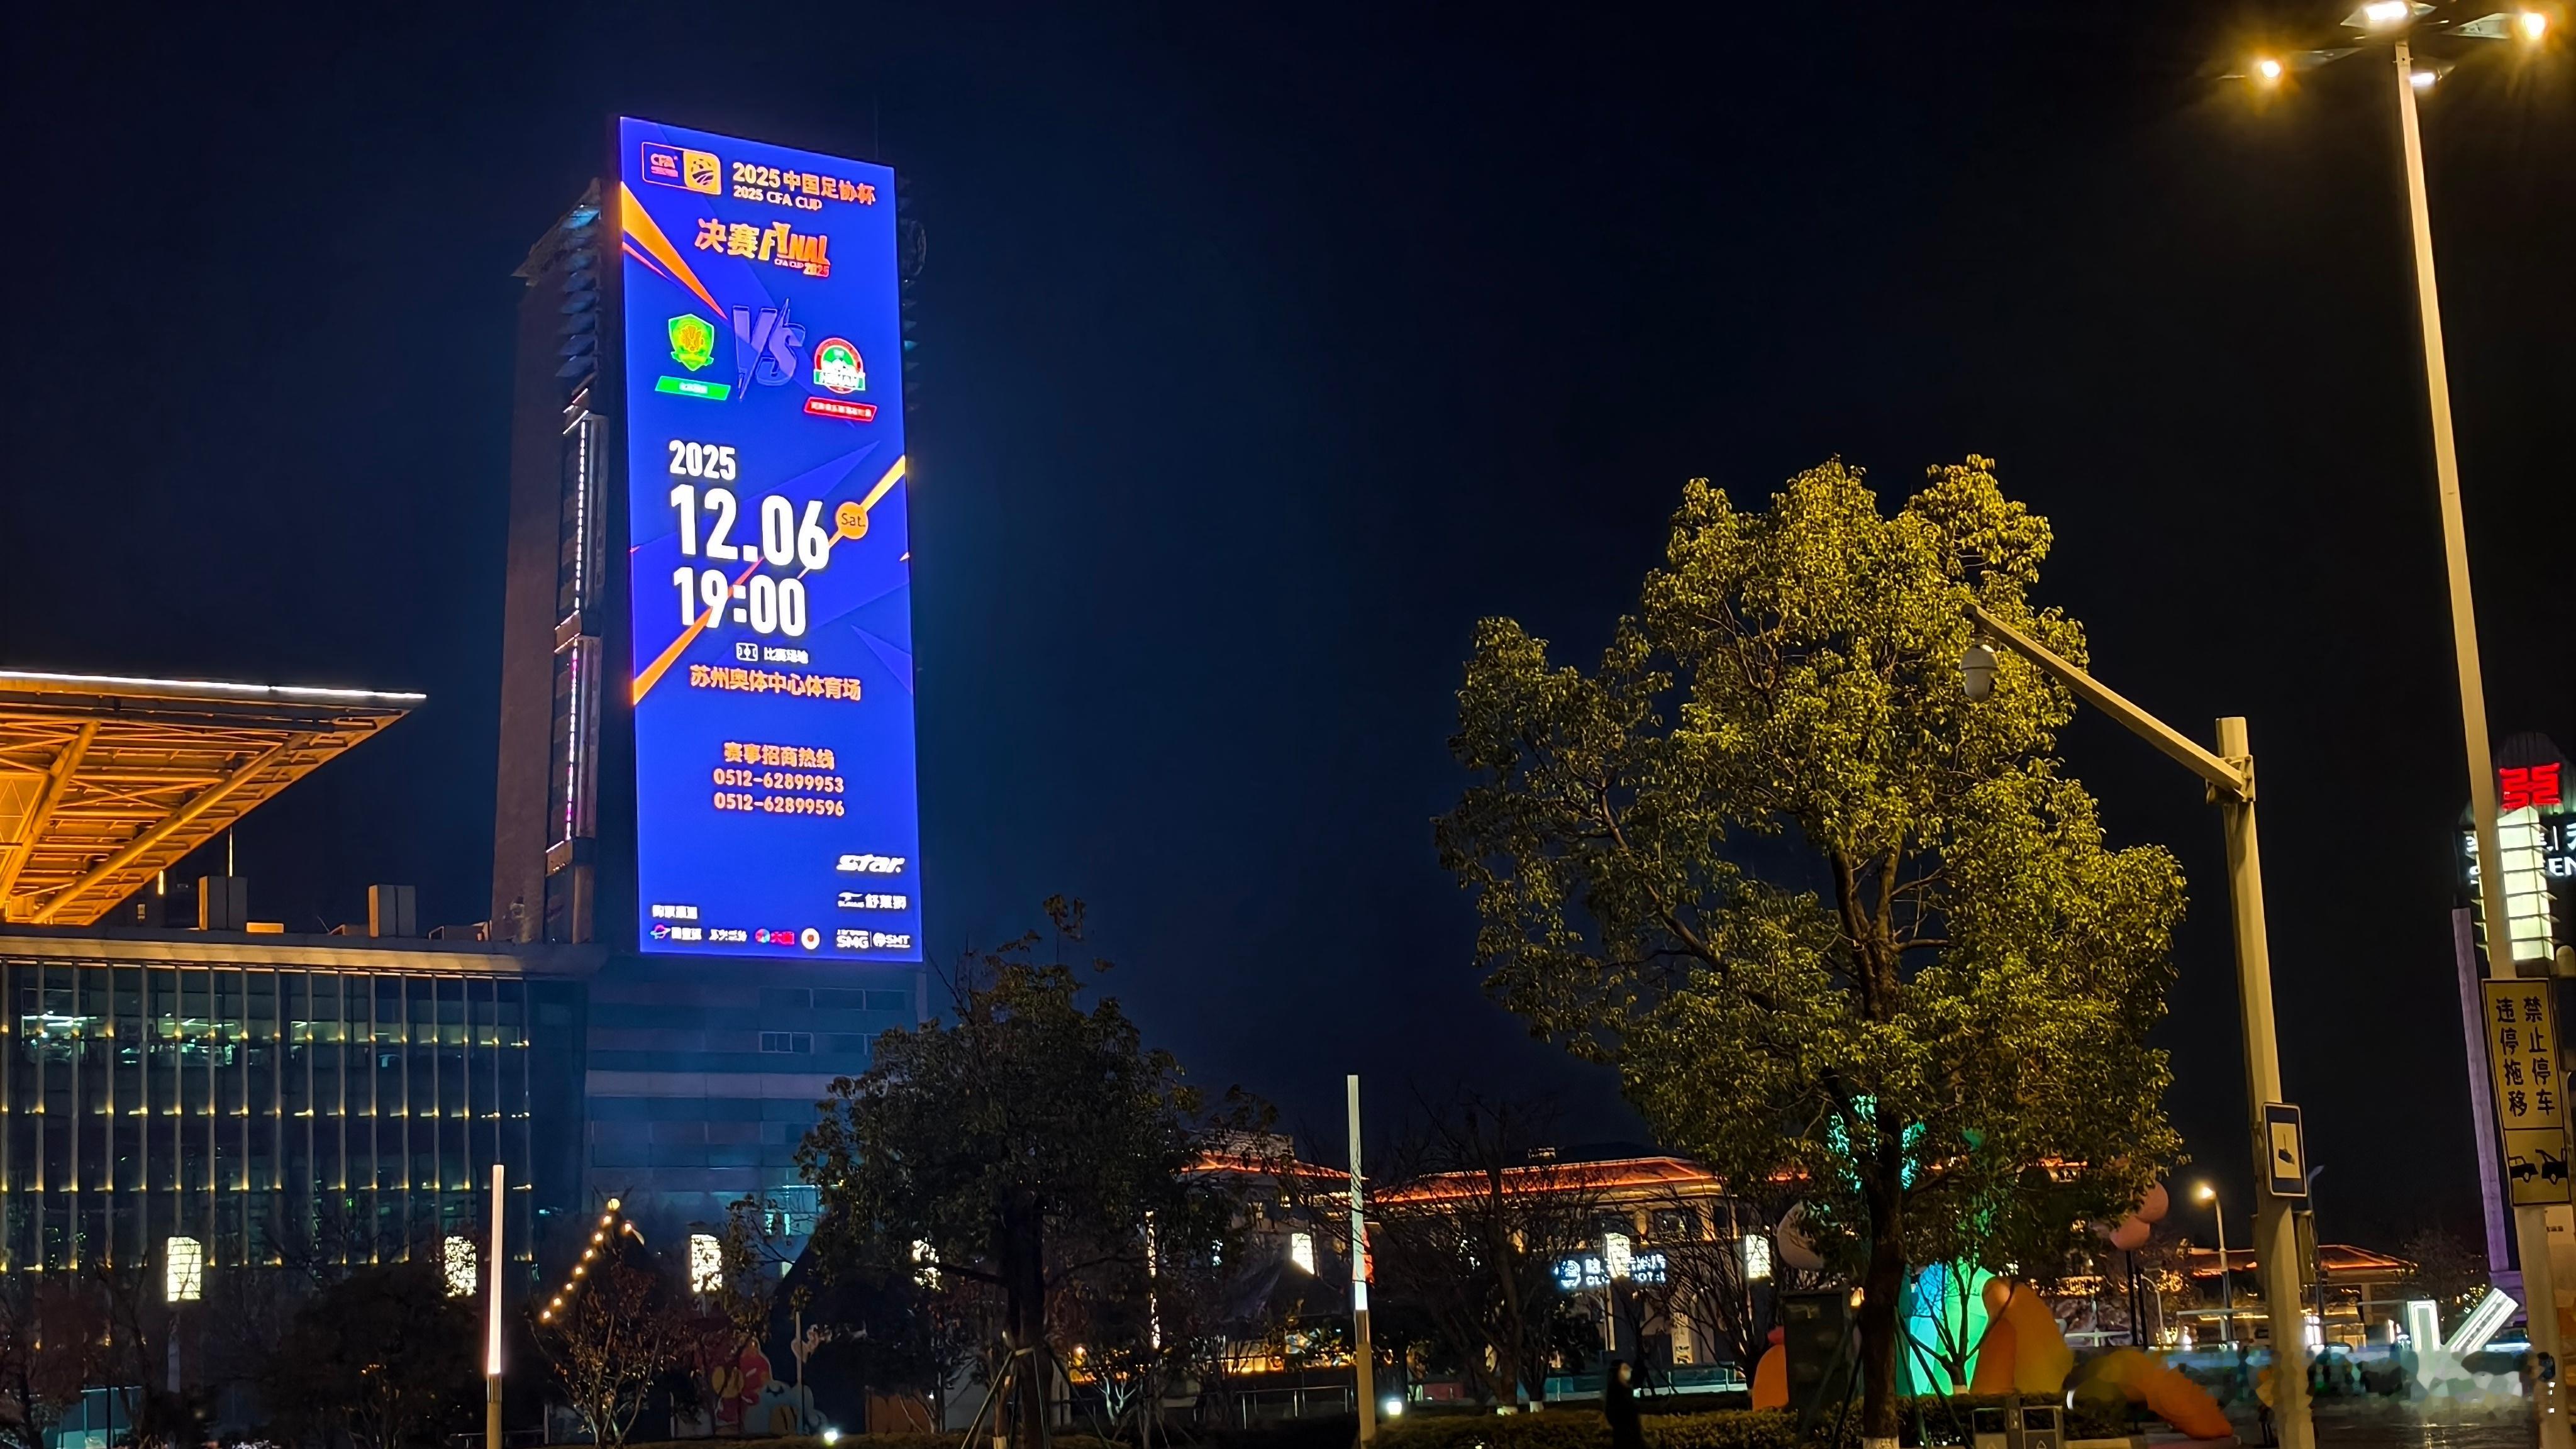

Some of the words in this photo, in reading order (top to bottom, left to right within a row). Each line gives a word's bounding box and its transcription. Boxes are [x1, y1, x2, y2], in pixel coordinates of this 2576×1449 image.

[733, 185, 763, 201] 2025
[766, 191, 793, 207] CFA
[795, 196, 823, 211] CUP
[694, 218, 760, 259] 决赛
[757, 221, 831, 262] FINAL
[732, 297, 806, 402] VS
[669, 439, 736, 480] 2025
[670, 484, 830, 570] 12.06
[673, 566, 806, 637] 19:00
[689, 663, 861, 701] 苏州奥体中心体育场
[723, 741, 835, 770] 赛事招商热线
[713, 768, 844, 793] 0512-62899953
[714, 792, 845, 817] 0512-62899596
[2496, 995, 2528, 1118] 违停拖移
[2523, 995, 2556, 1117] 禁止停车
